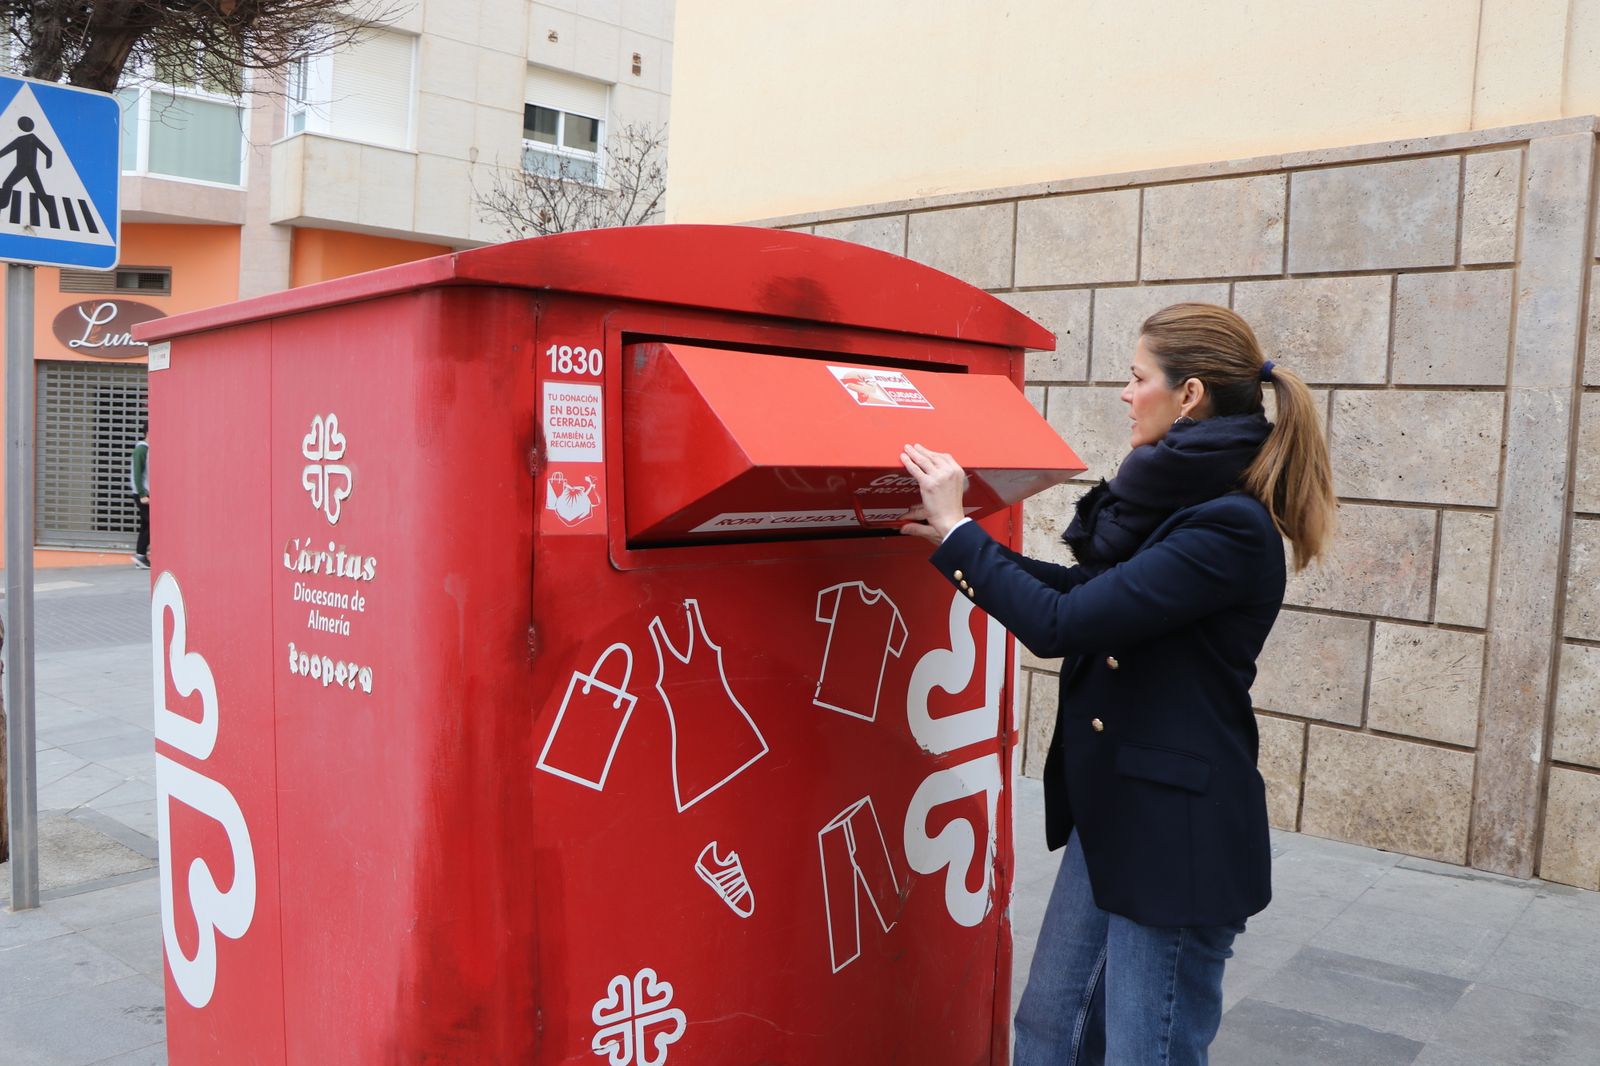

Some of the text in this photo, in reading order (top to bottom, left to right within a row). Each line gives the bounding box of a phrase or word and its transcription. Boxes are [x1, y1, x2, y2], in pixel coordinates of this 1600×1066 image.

[546, 345, 603, 376] 1830
[548, 393, 599, 403] TU DONACIÓN
[550, 405, 597, 417] EN BOLSA
[549, 417, 597, 429] CERRADA,
[552, 431, 595, 440] TAMBIÉN LA
[550, 440, 596, 449] RECICLAMOS
[715, 517, 765, 526] ROPA
[770, 514, 846, 525] CALZADO
[283, 536, 378, 582] Cáritas
[293, 582, 366, 612] Diocesana de
[307, 609, 351, 637] Almería
[287, 642, 373, 694] koopera
